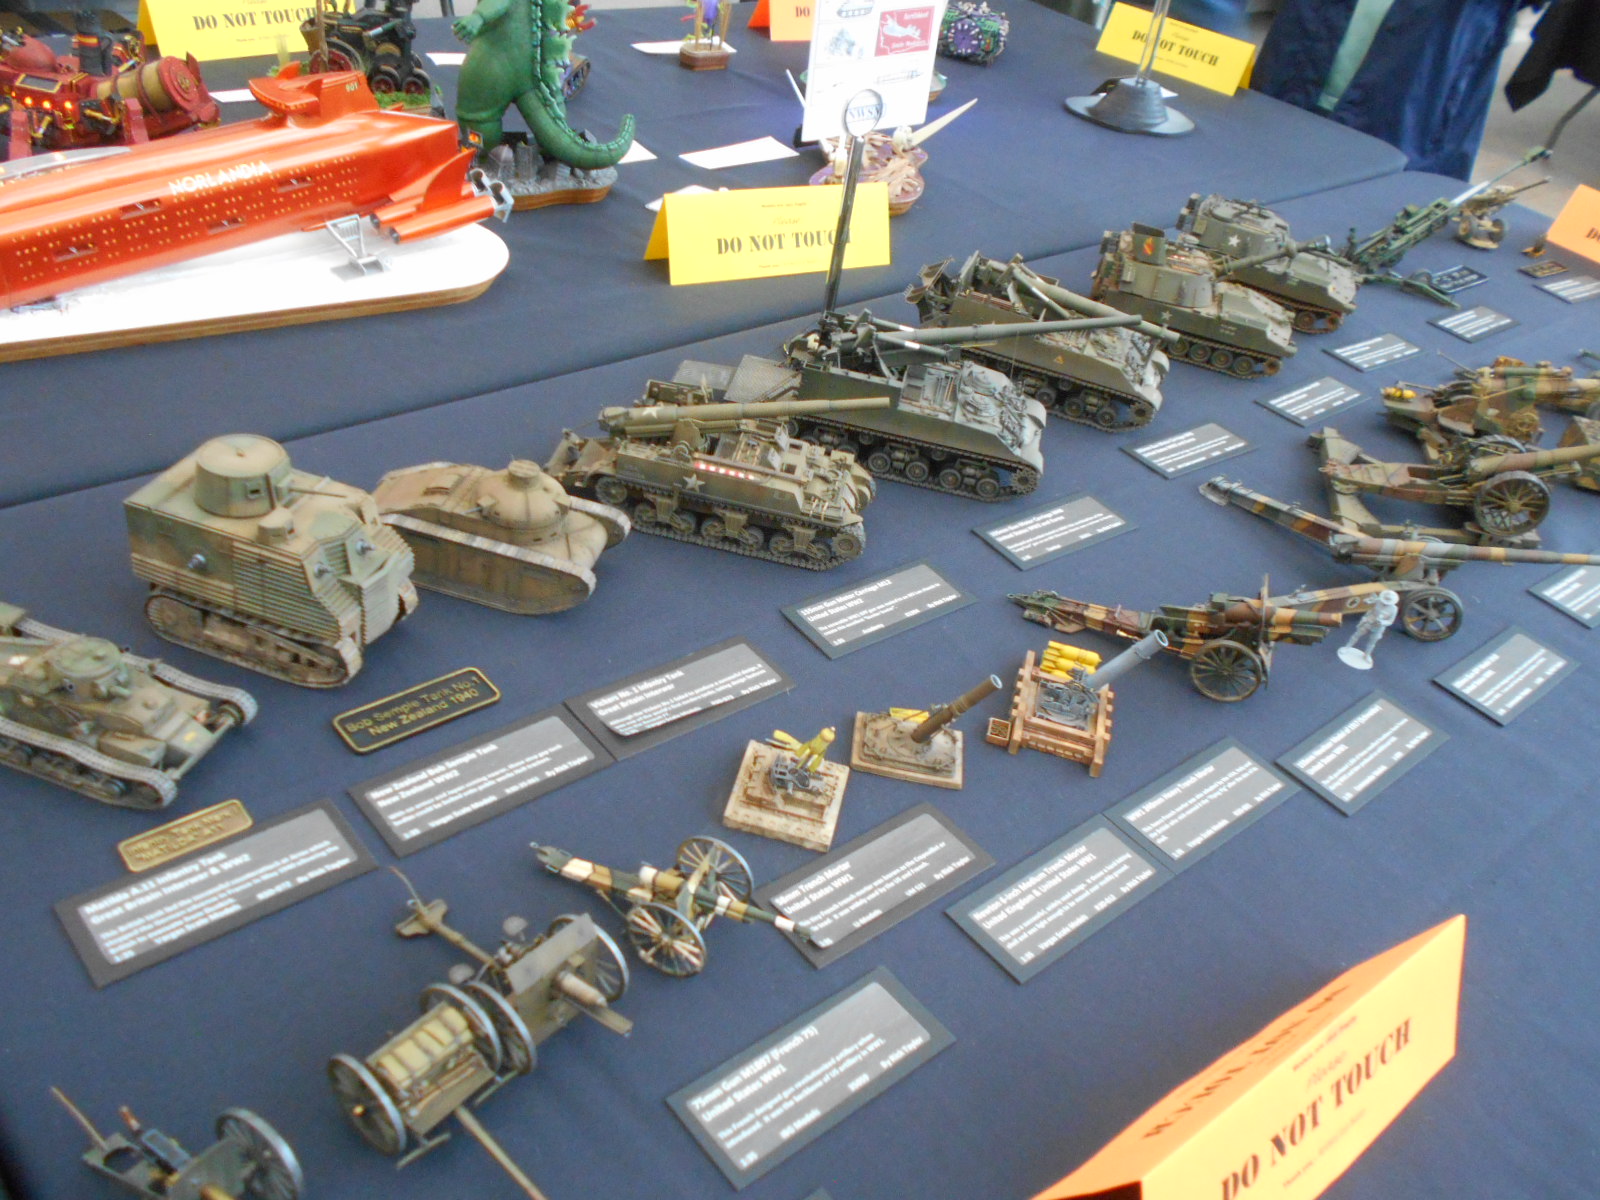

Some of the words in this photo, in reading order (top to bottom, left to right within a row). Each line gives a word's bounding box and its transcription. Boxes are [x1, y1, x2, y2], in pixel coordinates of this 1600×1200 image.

[193, 15, 218, 30] DO
[224, 13, 256, 29] NOT
[261, 6, 317, 26] TOUCH
[795, 5, 811, 17] DO
[1179, 44, 1220, 66] TOUCH
[169, 160, 272, 195] NORLANDIA
[717, 236, 742, 255] DO
[750, 233, 786, 253] NOT
[808, 611, 829, 621] United
[828, 605, 848, 614] States
[836, 594, 855, 603] Motor
[854, 585, 879, 596] Carriage
[590, 695, 619, 708] Vickers
[637, 678, 666, 691] Infantry
[665, 670, 684, 680] Tank
[598, 704, 620, 716] Great
[620, 696, 645, 708] Britain
[346, 717, 375, 734] Bob
[375, 701, 420, 723] Semple
[422, 687, 453, 705] Tank
[369, 721, 399, 737] New
[399, 703, 449, 725] Zealand
[449, 688, 479, 705] 1940
[370, 787, 392, 798] New
[392, 772, 428, 790] Zealand
[427, 766, 446, 776] Bob
[445, 753, 477, 768] Semple
[476, 744, 498, 755] Tank
[377, 796, 400, 807] New
[398, 780, 434, 798] Zealand
[433, 770, 459, 783] WW2
[84, 892, 130, 914] Matilda
[156, 864, 200, 885] Infantry
[199, 852, 226, 866] Tank
[90, 907, 124, 924] Great
[124, 891, 162, 910] Britain
[220, 854, 250, 870] WW2
[784, 897, 811, 914] United
[809, 886, 834, 901] States
[831, 874, 853, 888] WW1
[798, 875, 826, 892] Trench
[824, 862, 850, 879] Mortar
[973, 901, 1002, 920] Newton
[999, 888, 1022, 904] 6-inch
[1018, 872, 1047, 891] Medium
[1044, 859, 1067, 874] Trench
[1064, 846, 1086, 861] Mortar
[982, 911, 1008, 928] United
[1005, 894, 1035, 914] Kingdom
[1038, 875, 1062, 892] United
[1059, 865, 1080, 879] States
[1077, 853, 1096, 866] WW1
[692, 1087, 723, 1110] 75mm
[721, 1076, 743, 1091] Gun
[740, 1055, 770, 1079] M1897
[770, 1036, 804, 1060] (French
[802, 1026, 818, 1039] 75)
[702, 1096, 734, 1122] United
[733, 1080, 762, 1102] States
[760, 1064, 786, 1083] WW1
[1221, 1154, 1260, 1200] DO
[1270, 1098, 1323, 1166] NOT
[1331, 1017, 1412, 1108] TOUCH
